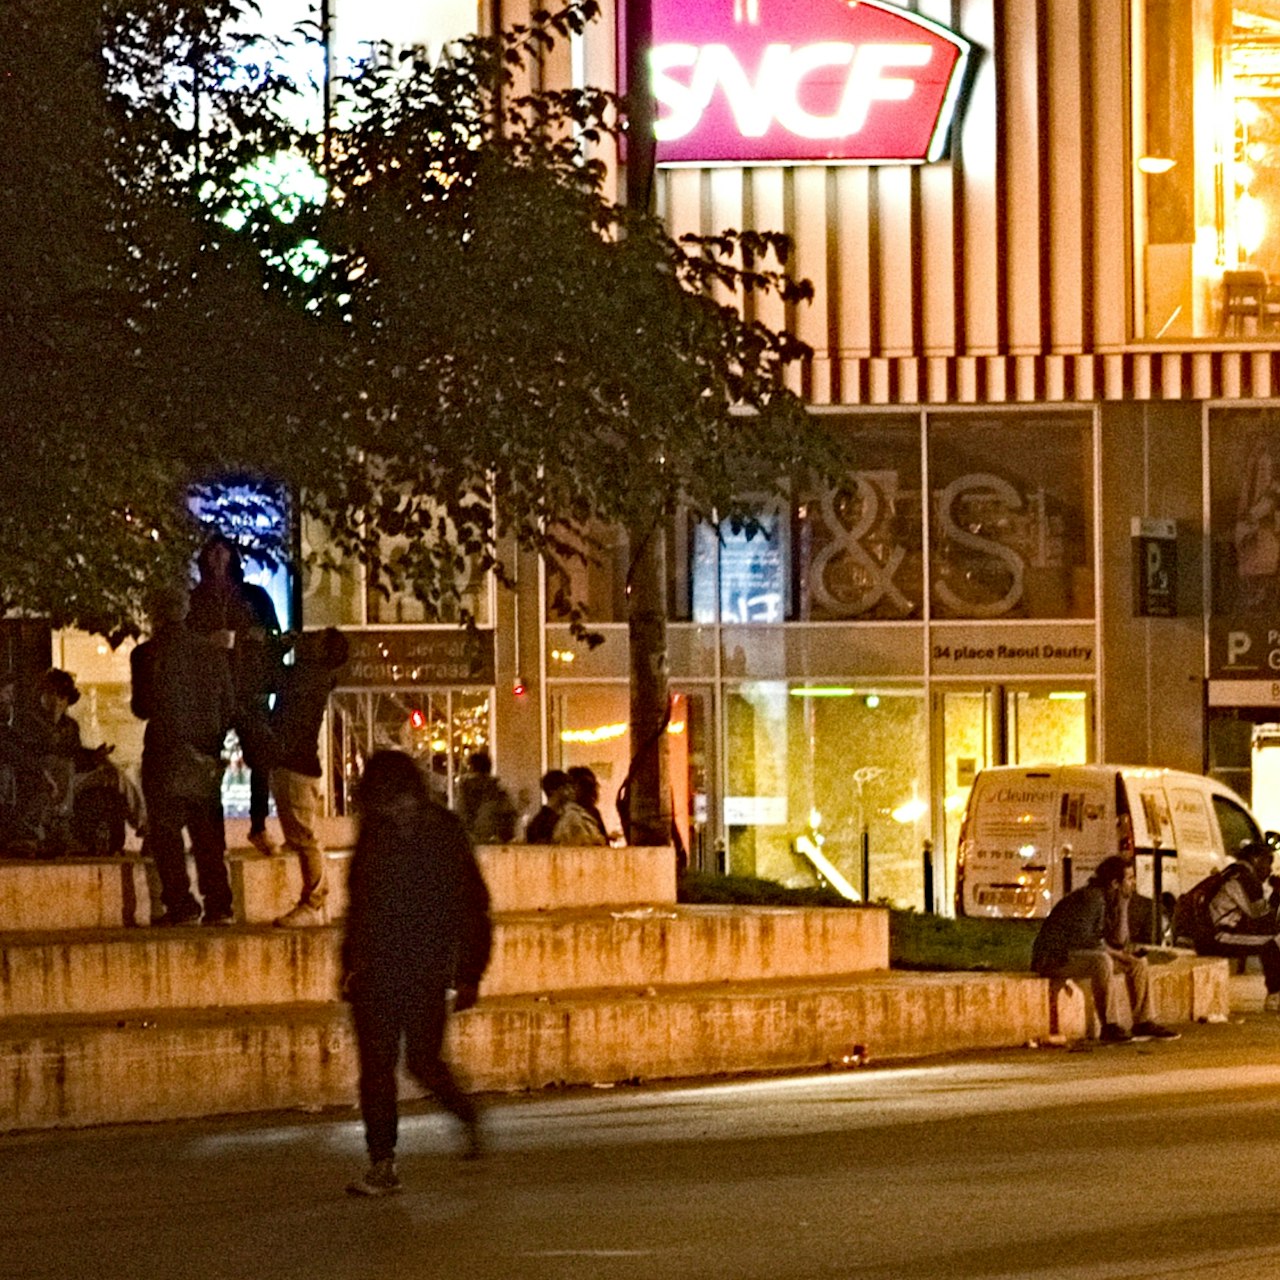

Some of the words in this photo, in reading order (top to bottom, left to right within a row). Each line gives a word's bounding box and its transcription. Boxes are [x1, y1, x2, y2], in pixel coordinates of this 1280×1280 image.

[651, 42, 933, 140] SNCF
[933, 646, 950, 659] 34
[954, 645, 994, 661] place
[998, 645, 1039, 659] Raoul
[1043, 645, 1092, 661] Dautry
[1227, 631, 1252, 664] P
